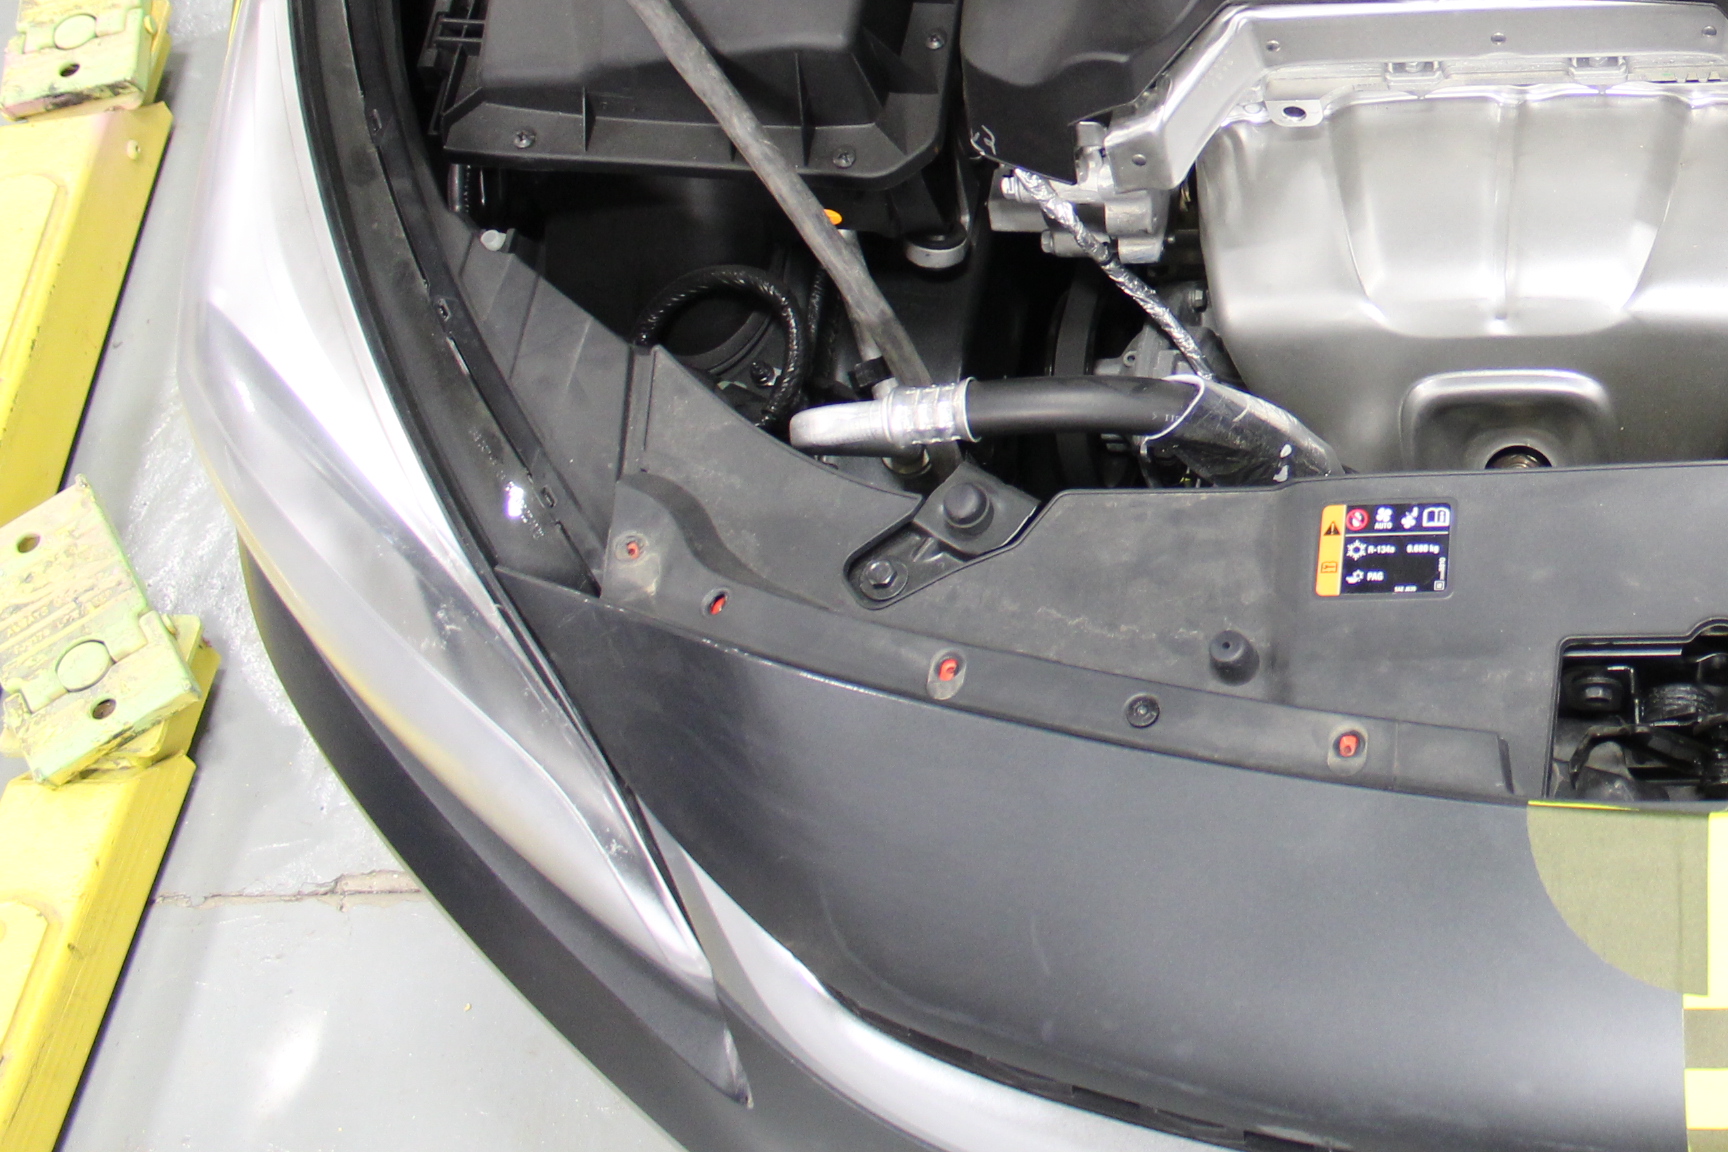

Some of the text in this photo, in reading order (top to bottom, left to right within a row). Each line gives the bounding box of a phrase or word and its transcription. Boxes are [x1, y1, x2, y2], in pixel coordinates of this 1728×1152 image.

[1374, 522, 1393, 530] AUTO
[1367, 545, 1396, 554] R-134a
[1366, 572, 1385, 581] PAG
